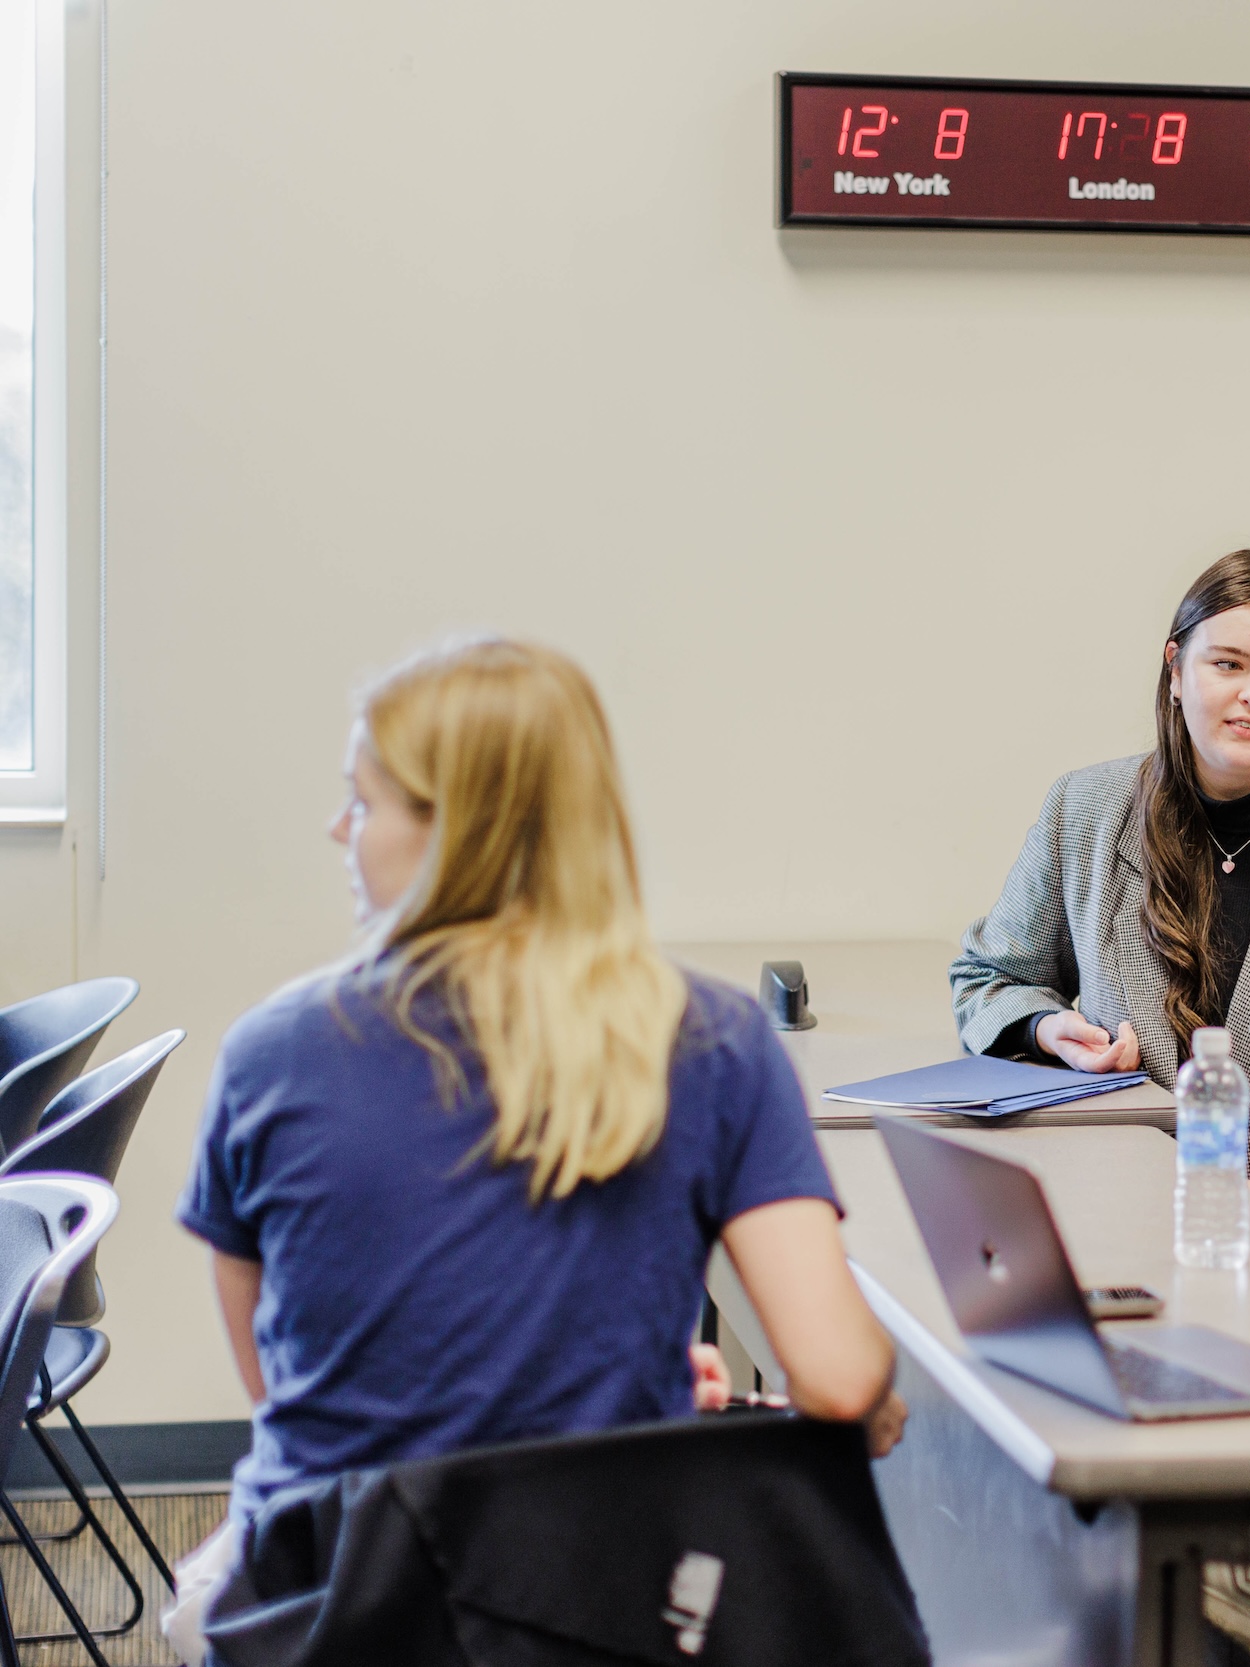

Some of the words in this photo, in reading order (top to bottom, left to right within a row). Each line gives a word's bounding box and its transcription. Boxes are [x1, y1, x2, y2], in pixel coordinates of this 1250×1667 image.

[934, 108, 968, 159] 8
[834, 172, 889, 194] New
[894, 173, 950, 195] York
[1069, 177, 1154, 200] London
